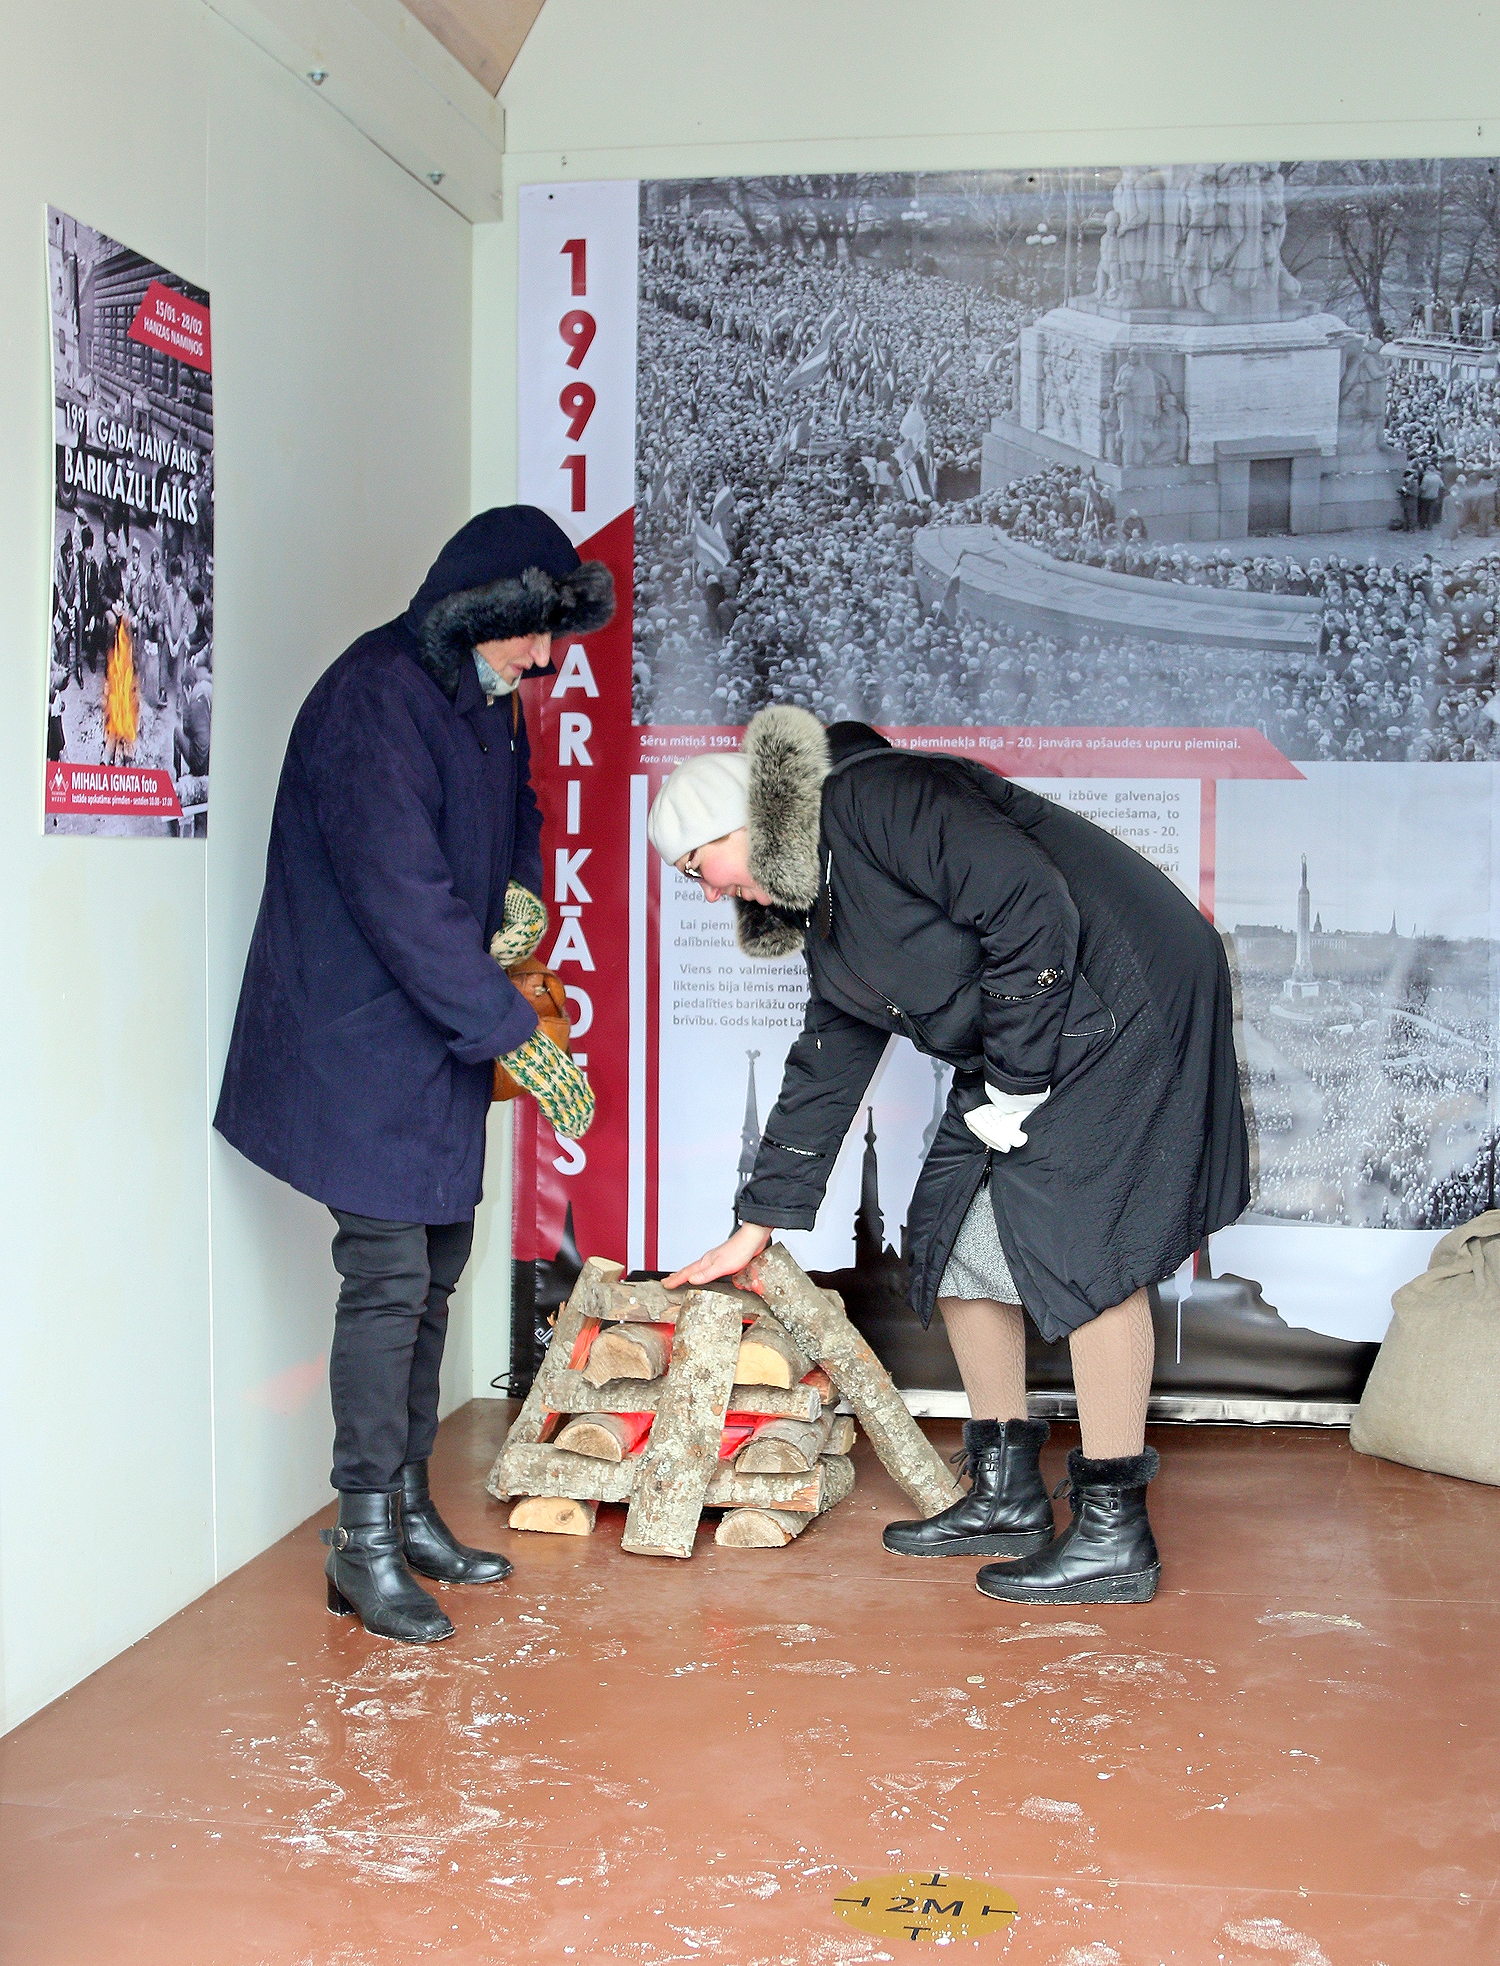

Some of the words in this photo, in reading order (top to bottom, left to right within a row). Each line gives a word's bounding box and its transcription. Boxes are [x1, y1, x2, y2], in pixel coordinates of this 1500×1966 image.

[155, 299, 177, 324] 15/01
[181, 312, 203, 336] 28/02
[143, 316, 170, 342] HANZAS
[170, 330, 204, 357] NAMIŅOS
[558, 238, 597, 512] 1991
[65, 401, 95, 438] 1991.
[98, 416, 135, 454] GADA
[138, 433, 198, 475] JANVĀRIS
[64, 445, 146, 510] BARIKĀŽU
[151, 478, 198, 525] LAIKS
[640, 734, 667, 747] Sēru
[669, 735, 706, 749] mītiņš
[709, 735, 741, 747] 1991.
[909, 735, 976, 750] pieminekļa
[978, 736, 1004, 750] Rīgā
[1017, 737, 1035, 748] 20.
[1038, 737, 1082, 750] janvāra
[1085, 736, 1143, 750] apšaudes
[1145, 739, 1182, 750] upuru
[1184, 737, 1242, 751] piemiņai.
[639, 754, 660, 764] Foto
[71, 771, 109, 791] MIHAILA
[110, 773, 140, 793] IGNATA
[141, 774, 158, 794] foto
[1068, 789, 1108, 801] izbūve
[1114, 790, 1180, 803] galvenajos
[1075, 807, 1161, 821] nepieciešama,
[1167, 809, 1180, 819] to
[1110, 826, 1150, 837] dienas
[1161, 827, 1179, 837] 20.
[1134, 843, 1180, 855] atradās
[680, 919, 696, 930] Lai
[674, 936, 735, 948] dalībnieku
[680, 963, 712, 975] Viens
[718, 966, 733, 975] no
[673, 980, 715, 992] liktenis
[718, 981, 740, 994] bija
[743, 981, 774, 993] lēmis
[777, 984, 803, 993] man
[673, 997, 733, 1010] piedalīties
[736, 997, 785, 1010] barikāžu
[673, 1014, 717, 1027] brīvību.
[719, 1015, 752, 1027] Gods
[752, 1015, 788, 1029] kalpot
[885, 1896, 964, 1917] 2M
